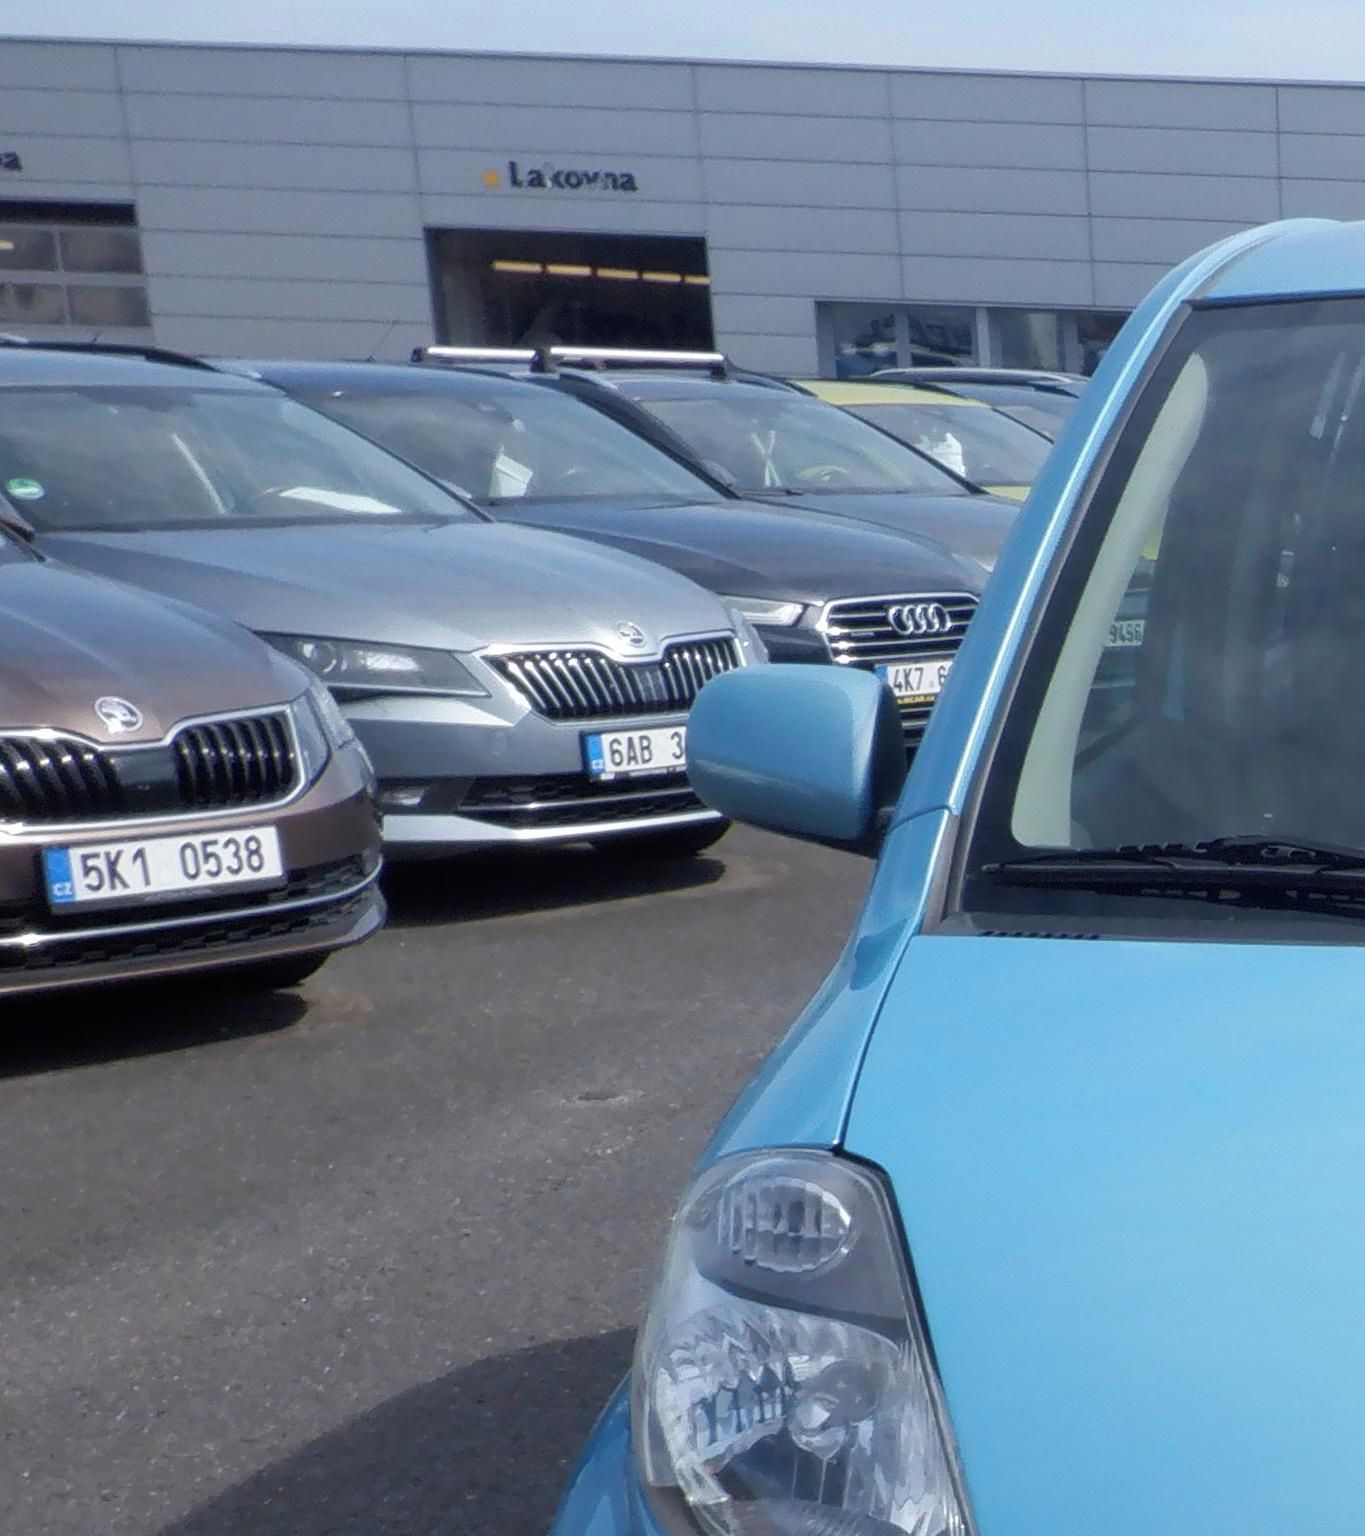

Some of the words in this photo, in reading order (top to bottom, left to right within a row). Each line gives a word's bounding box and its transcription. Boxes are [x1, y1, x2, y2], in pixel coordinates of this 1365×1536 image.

[508, 160, 638, 192] Lakovna
[609, 735, 653, 767] 6AB
[670, 731, 684, 760] 3
[80, 846, 151, 891] 5K1
[179, 834, 264, 880] 0538
[53, 882, 73, 897] CZ
